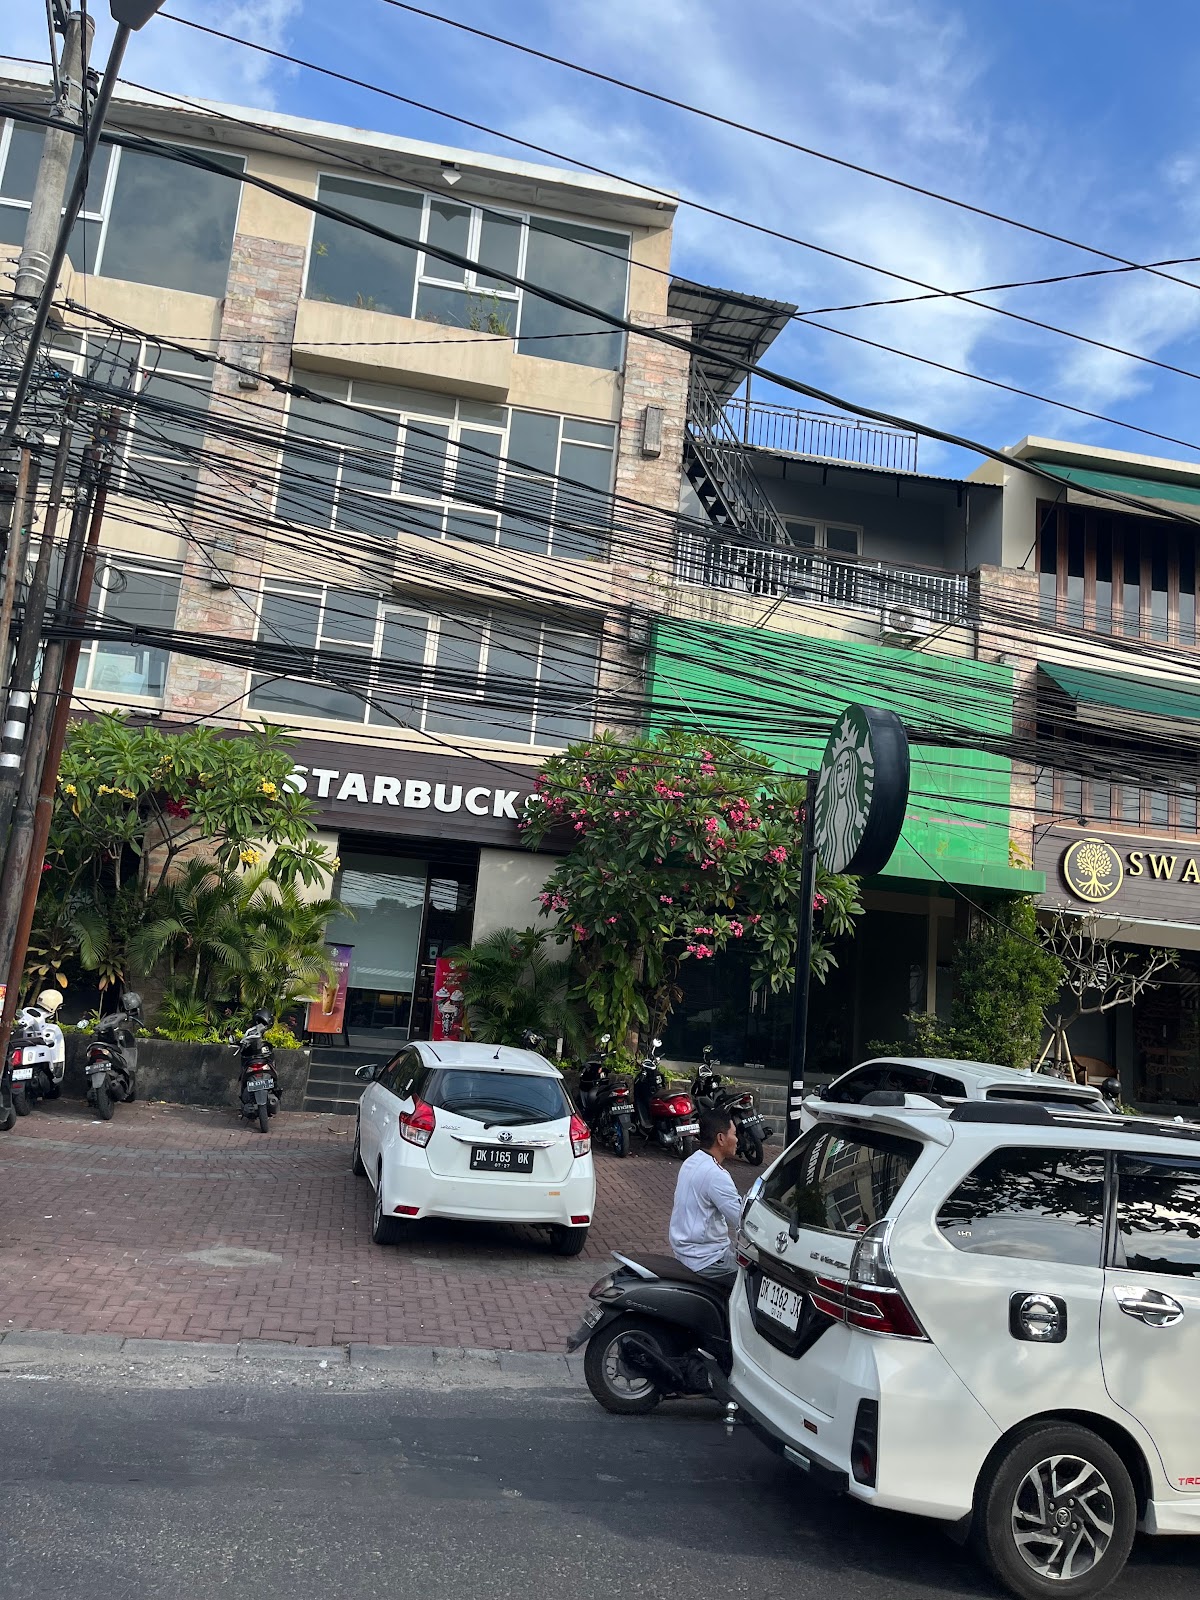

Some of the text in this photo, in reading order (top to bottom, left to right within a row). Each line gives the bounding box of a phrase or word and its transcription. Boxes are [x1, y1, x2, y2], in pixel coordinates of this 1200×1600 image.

[1129, 851, 1200, 884] SWA
[476, 1150, 487, 1161] DK
[490, 1151, 511, 1163] 1165
[760, 1280, 770, 1300] DK
[770, 1285, 789, 1311] 1162
